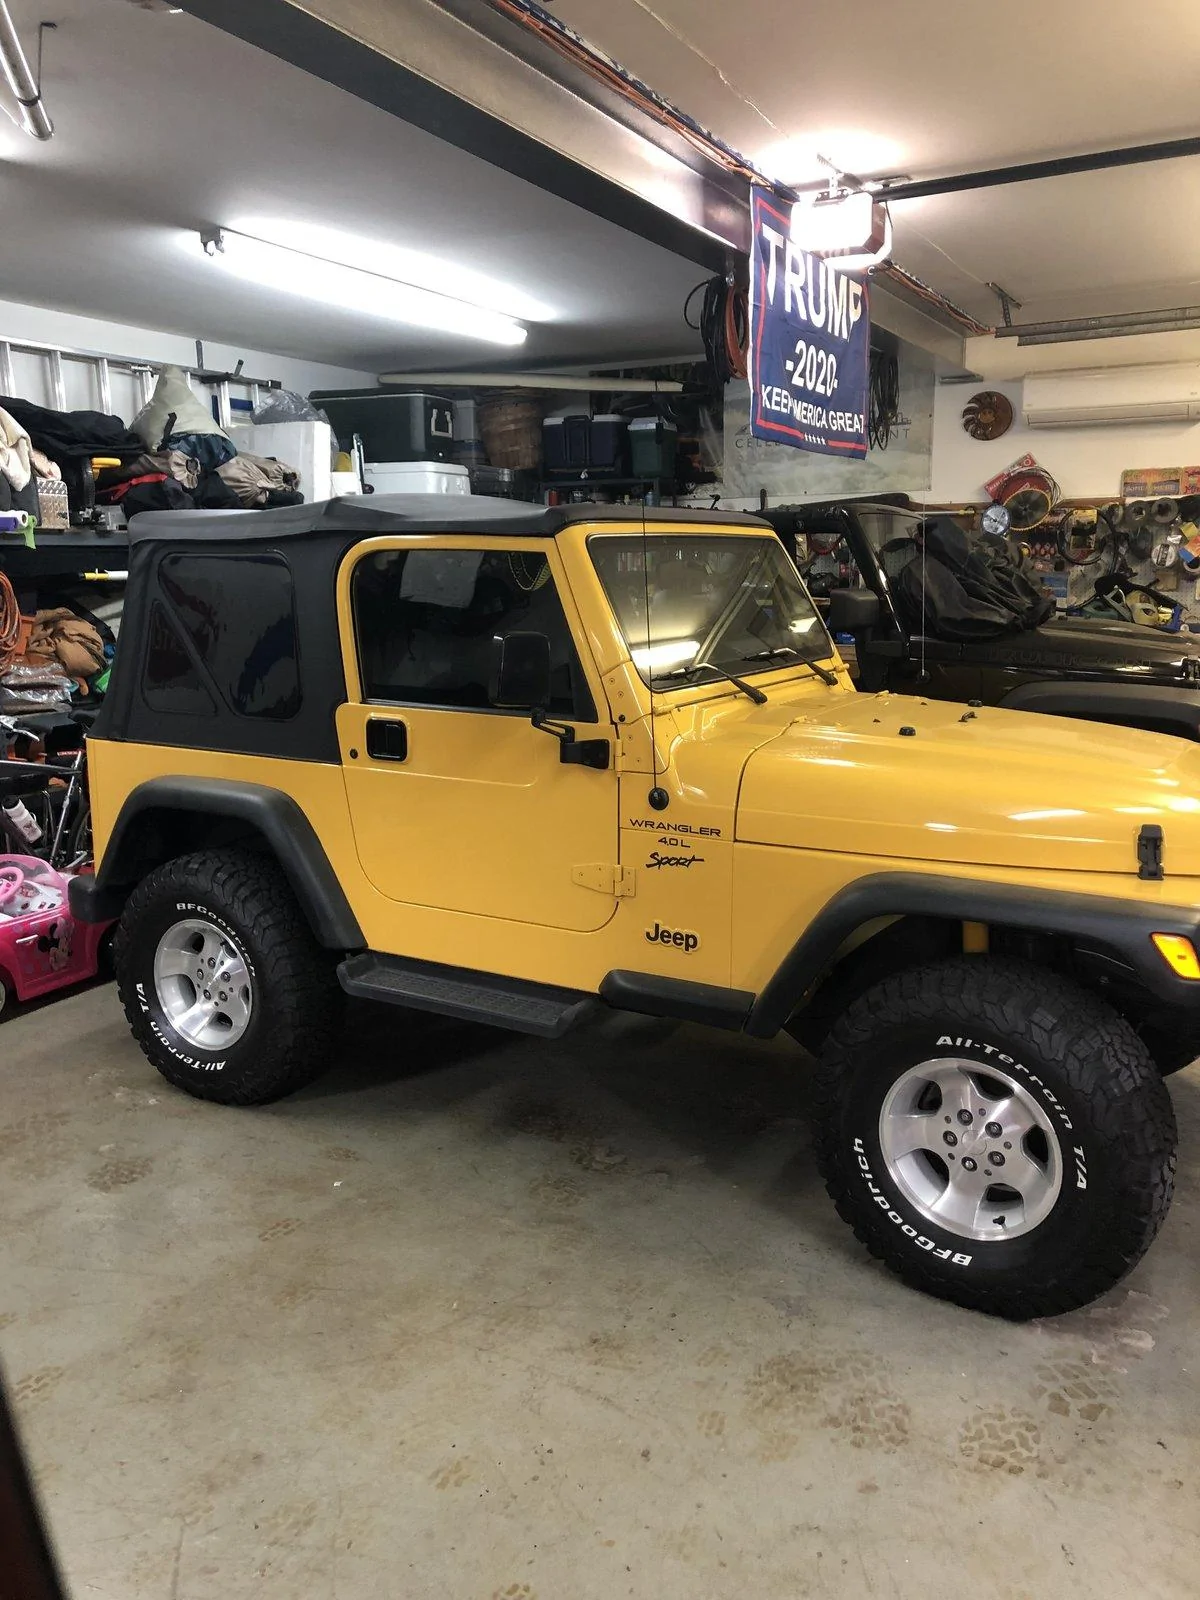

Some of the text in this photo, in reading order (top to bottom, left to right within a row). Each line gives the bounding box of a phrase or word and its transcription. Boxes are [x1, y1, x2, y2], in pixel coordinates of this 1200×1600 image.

[762, 223, 863, 341] TRUMP
[629, 818, 721, 837] WRANGLER
[646, 852, 705, 870] Sport
[645, 923, 698, 952] Jeep
[135, 983, 150, 1014] T/A
[936, 1035, 1088, 1190] All-Terrain T/A
[850, 1137, 973, 1267] BFGoodrich
